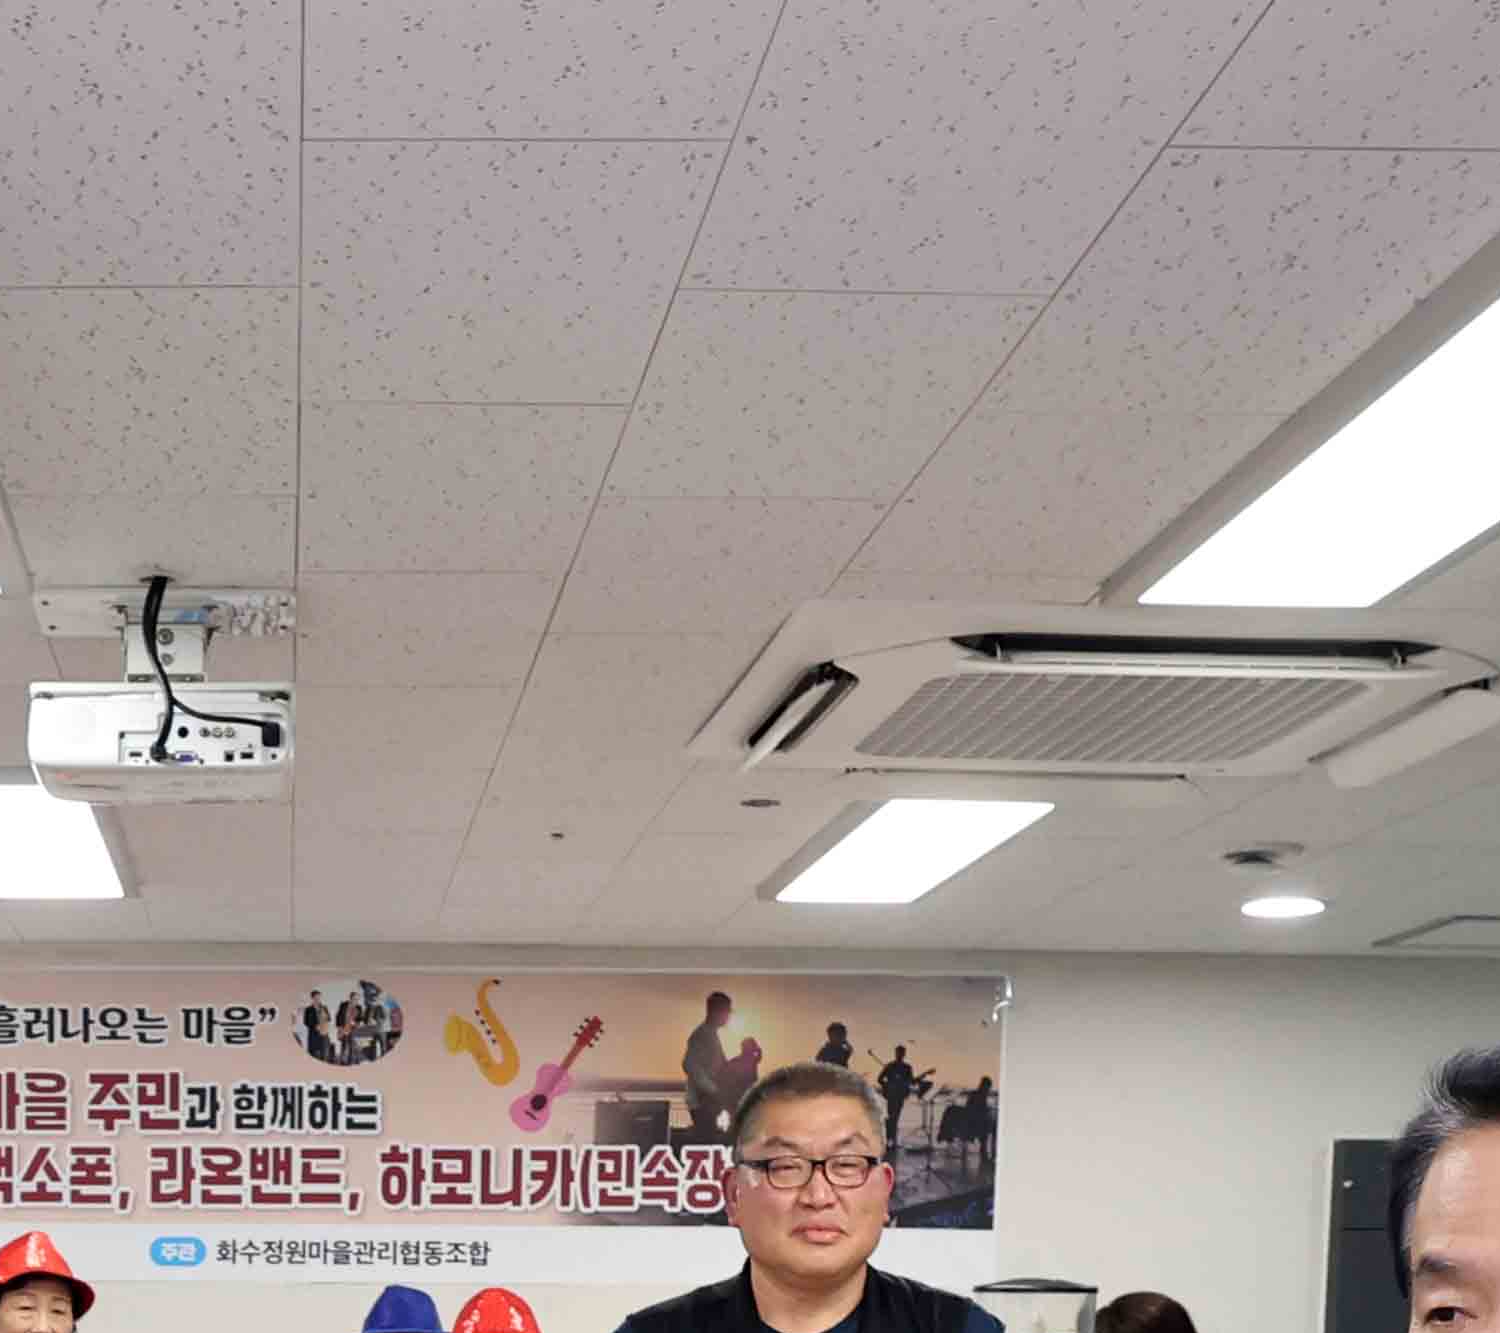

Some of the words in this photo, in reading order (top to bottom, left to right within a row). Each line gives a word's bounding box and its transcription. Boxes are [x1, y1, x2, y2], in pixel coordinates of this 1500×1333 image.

[182, 1005, 277, 1045] 마을”
[87, 1071, 221, 1131] 주민과
[233, 1084, 379, 1131] 함께하는
[151, 1145, 361, 1212] 라온밴드,
[379, 1146, 729, 1210] 하모니카(민속장
[159, 1243, 198, 1264] 주관
[216, 1240, 491, 1267] 화수정원마을관리협동조합
